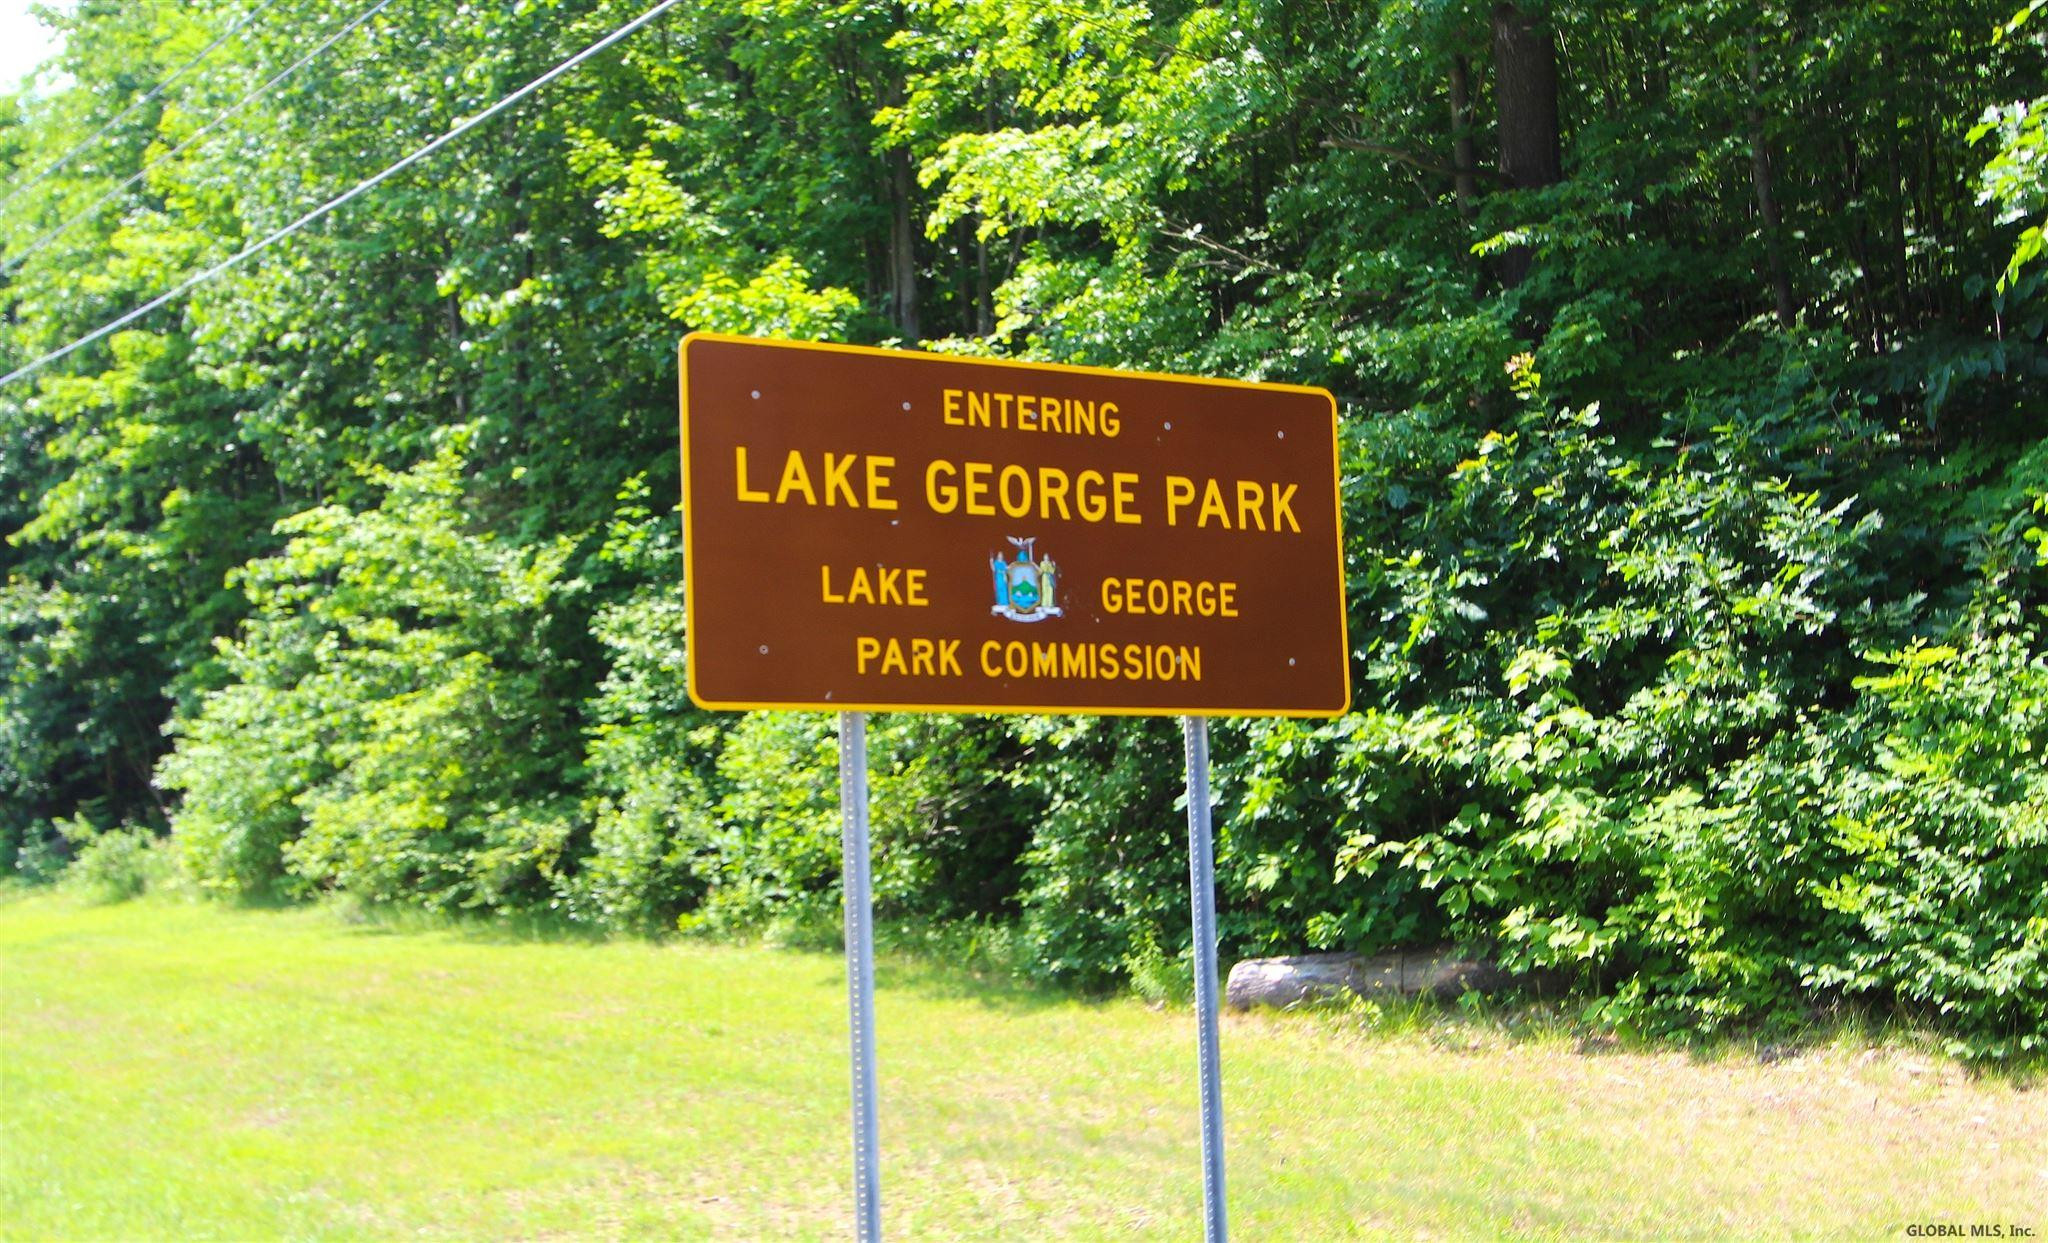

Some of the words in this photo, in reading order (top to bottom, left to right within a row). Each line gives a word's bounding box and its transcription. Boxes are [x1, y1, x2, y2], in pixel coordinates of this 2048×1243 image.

[942, 388, 1121, 438] ENTERING
[735, 446, 898, 511] LAKE
[925, 459, 1142, 525] GEORGE
[1165, 475, 1301, 533] PARK
[821, 565, 929, 607] LAKE
[1101, 577, 1239, 618] GEORGE
[856, 636, 963, 677] PARK
[980, 640, 1201, 682] COMMISSION
